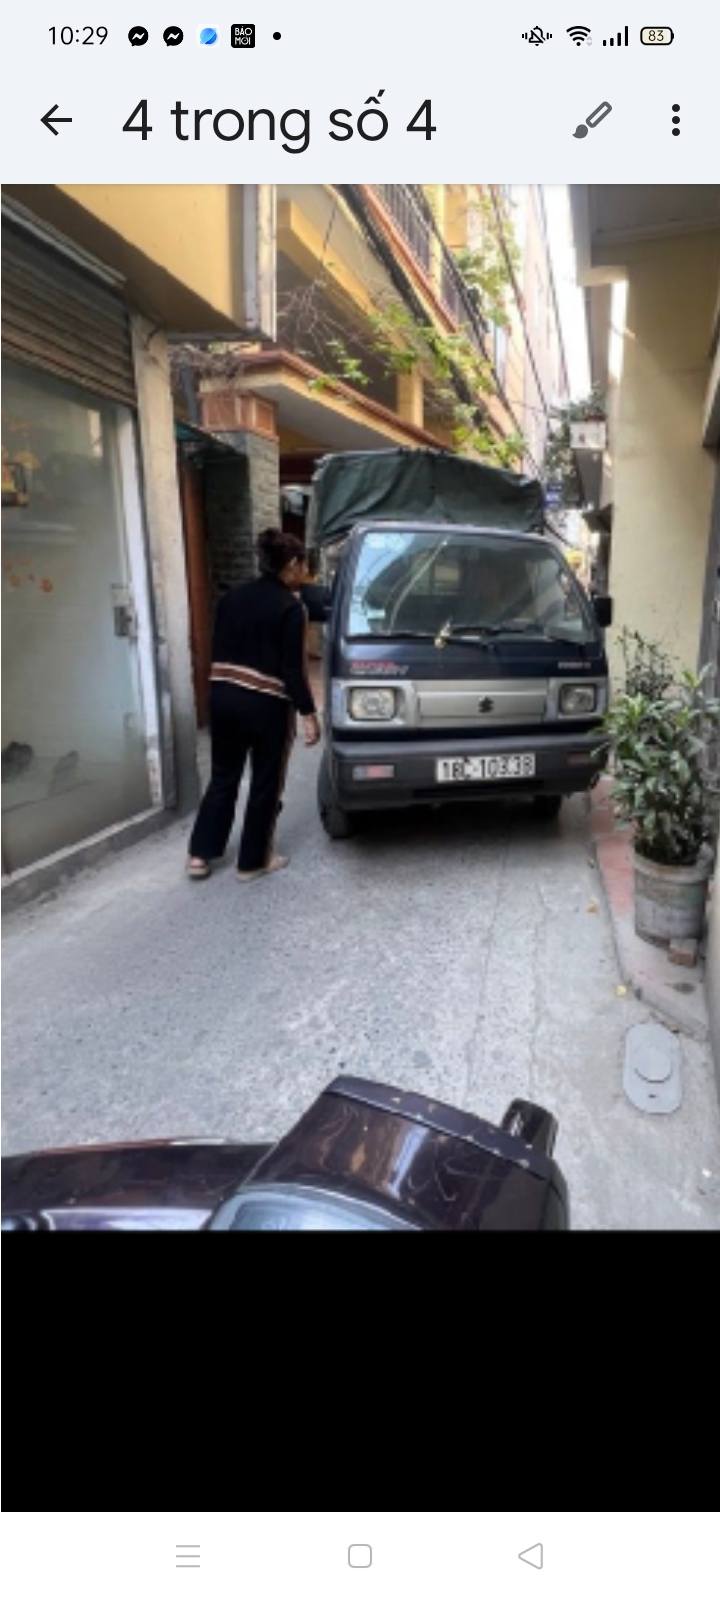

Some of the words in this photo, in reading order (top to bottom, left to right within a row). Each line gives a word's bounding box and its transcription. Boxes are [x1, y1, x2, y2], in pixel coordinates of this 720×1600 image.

[48, 26, 109, 46] 10:29
[648, 30, 665, 42] 83
[122, 99, 153, 141] 4
[170, 100, 311, 155] trong
[328, 88, 389, 142] số
[406, 99, 437, 141] 4
